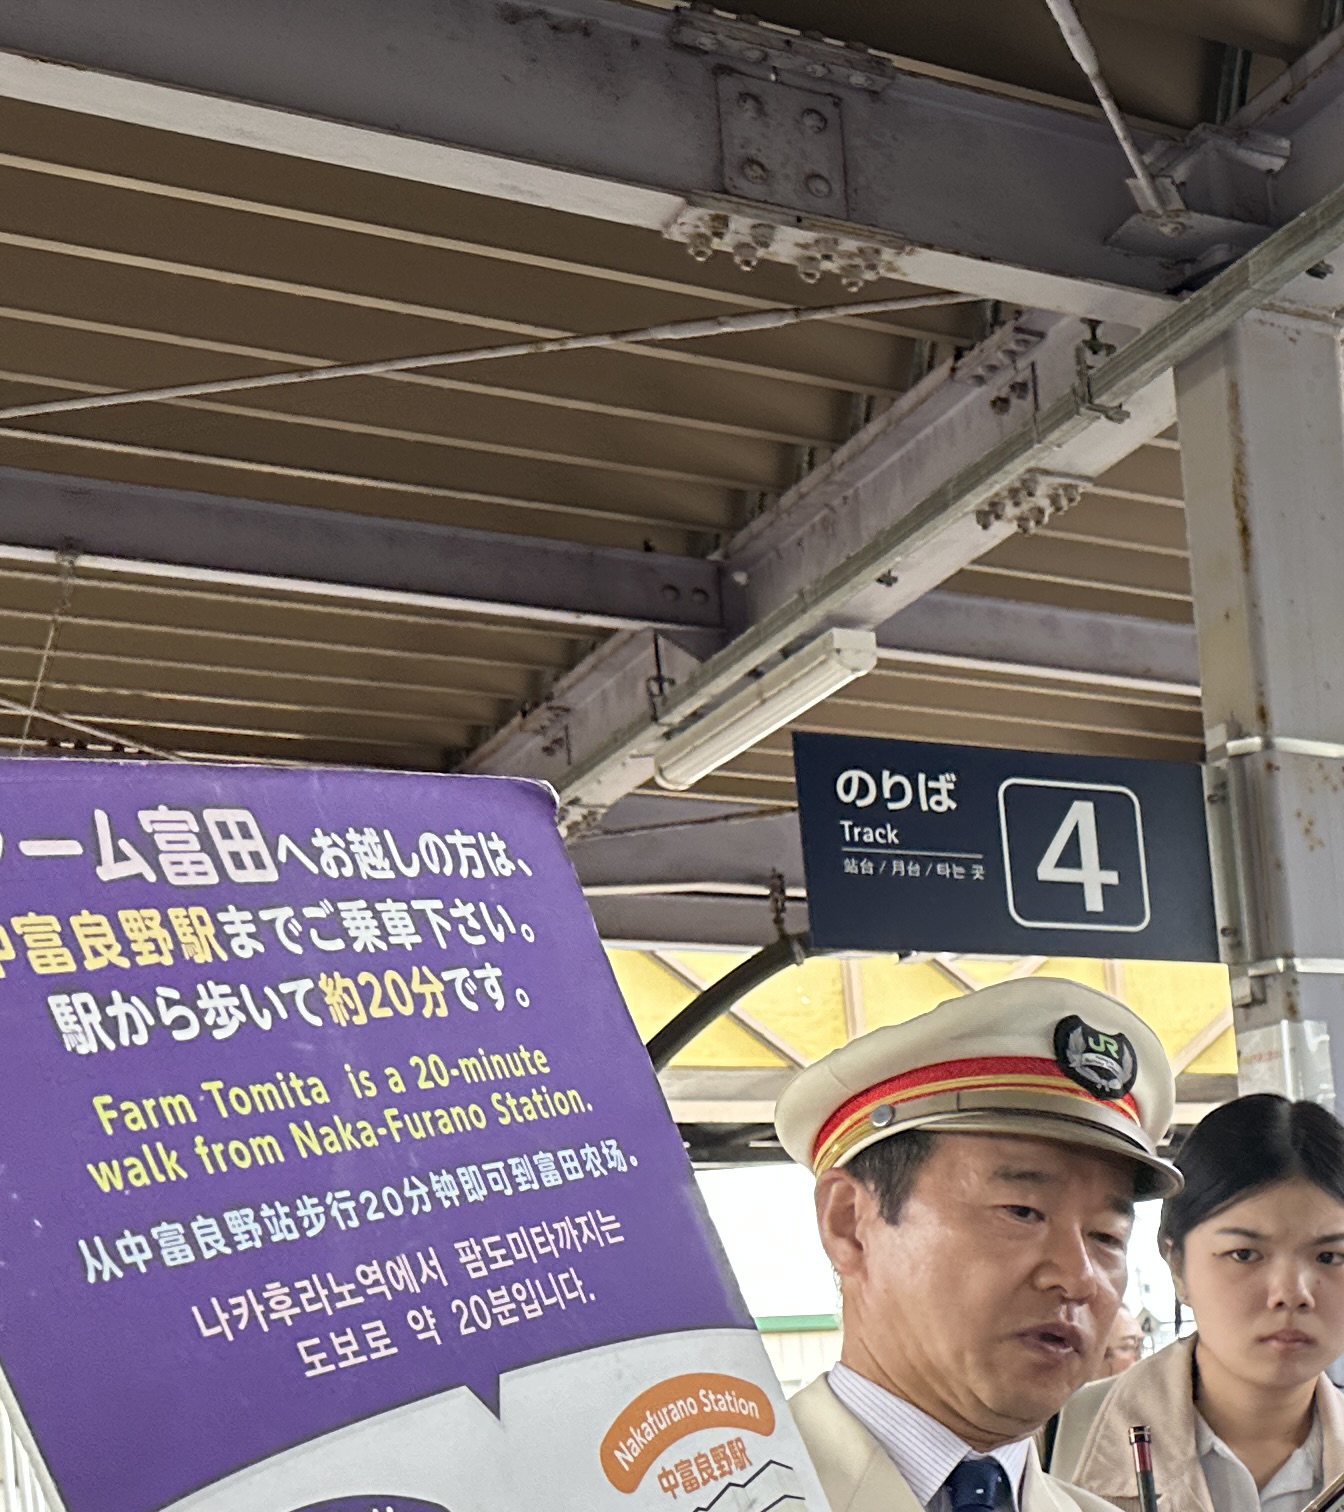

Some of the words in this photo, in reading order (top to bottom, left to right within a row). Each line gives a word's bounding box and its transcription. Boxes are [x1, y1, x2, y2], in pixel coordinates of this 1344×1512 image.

[836, 768, 957, 814] のりば
[839, 819, 899, 845] Track
[0, 803, 533, 887] ーム富田へお越しの方は、
[843, 856, 875, 876] 站台
[1036, 800, 1119, 913] 4
[47, 960, 531, 1055] 駅から歩いて約20分です。
[1087, 1033, 1120, 1060] JR
[92, 1094, 197, 1135] Farm
[200, 1072, 330, 1118] Tomita
[343, 1063, 377, 1098] is
[384, 1066, 406, 1093] a
[409, 1044, 551, 1090] 20-minute
[86, 1141, 188, 1193] walk
[194, 1135, 285, 1174] from
[288, 1101, 487, 1158] Naka-Furano
[490, 1085, 593, 1126] Station.
[78, 1138, 639, 1284] 从中富良野站步行20分钟即可到富田农场。
[192, 1246, 449, 1342] 나카후라노역에서
[453, 1209, 625, 1279] 팜도미타까지는
[296, 1319, 398, 1378] 도보로
[406, 1305, 443, 1345] 약
[450, 1267, 596, 1336] 20분입니다.
[613, 1395, 699, 1472] Nakafurano
[699, 1388, 760, 1420] Station
[657, 1436, 753, 1500] 中富良野駅
